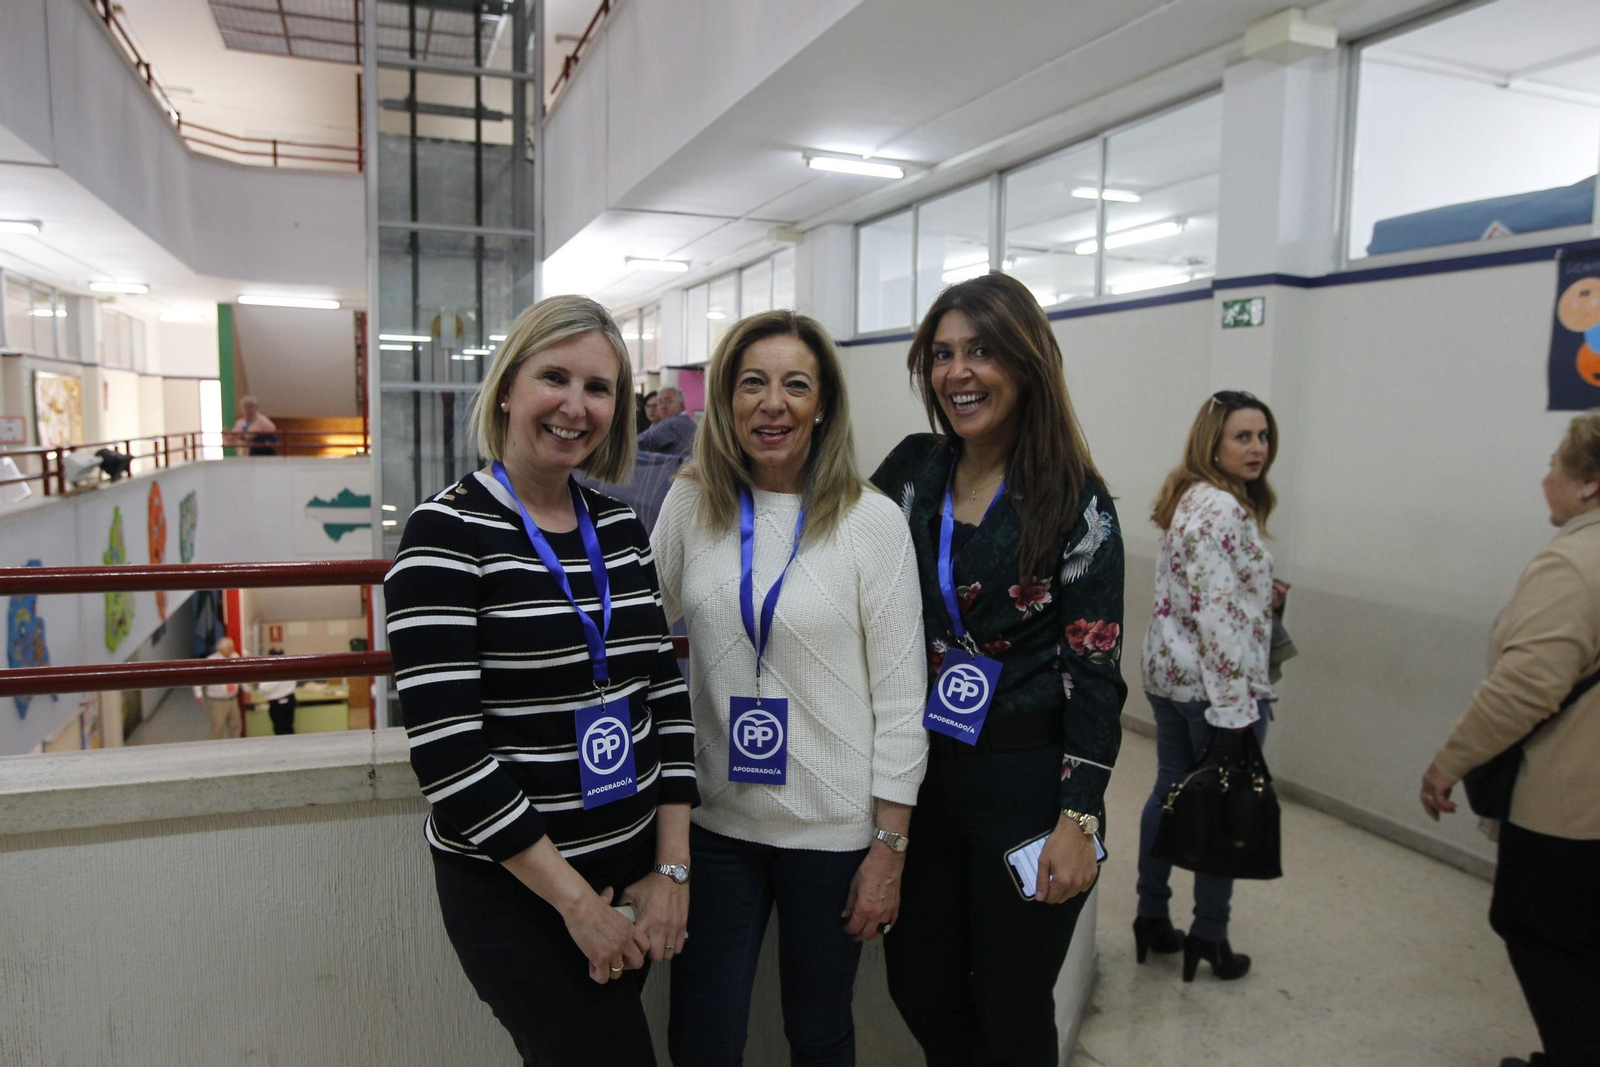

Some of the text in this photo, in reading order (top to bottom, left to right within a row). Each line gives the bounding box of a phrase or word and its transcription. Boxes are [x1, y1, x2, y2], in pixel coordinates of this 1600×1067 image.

[946, 676, 979, 702] PP
[928, 713, 975, 734] APODERADO/A
[743, 725, 773, 748] PP
[592, 734, 620, 764] PP
[732, 766, 782, 776] APODERADO/A
[587, 777, 633, 796] APODERADO/A
